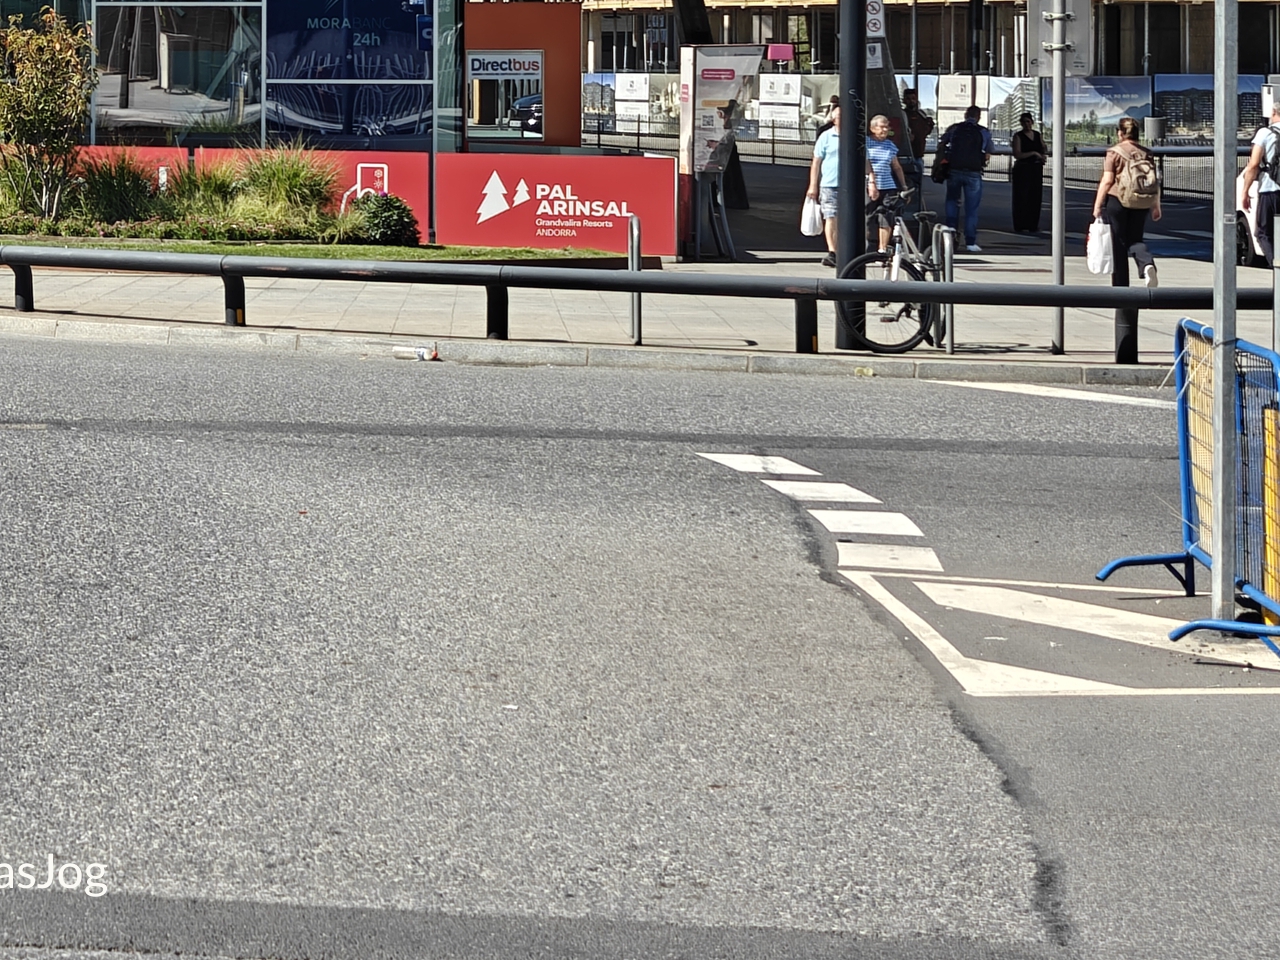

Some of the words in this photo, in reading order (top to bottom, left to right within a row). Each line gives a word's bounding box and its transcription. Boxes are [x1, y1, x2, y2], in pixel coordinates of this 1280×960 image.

[306, 16, 392, 30] MORABANC
[352, 32, 382, 47] 24h
[470, 57, 541, 73] Directbus
[535, 183, 579, 200] PAL
[535, 200, 635, 217] ARINSAL
[535, 218, 581, 228] Grandvalira
[582, 219, 614, 228] Resorts
[535, 228, 577, 237] ANDORRA
